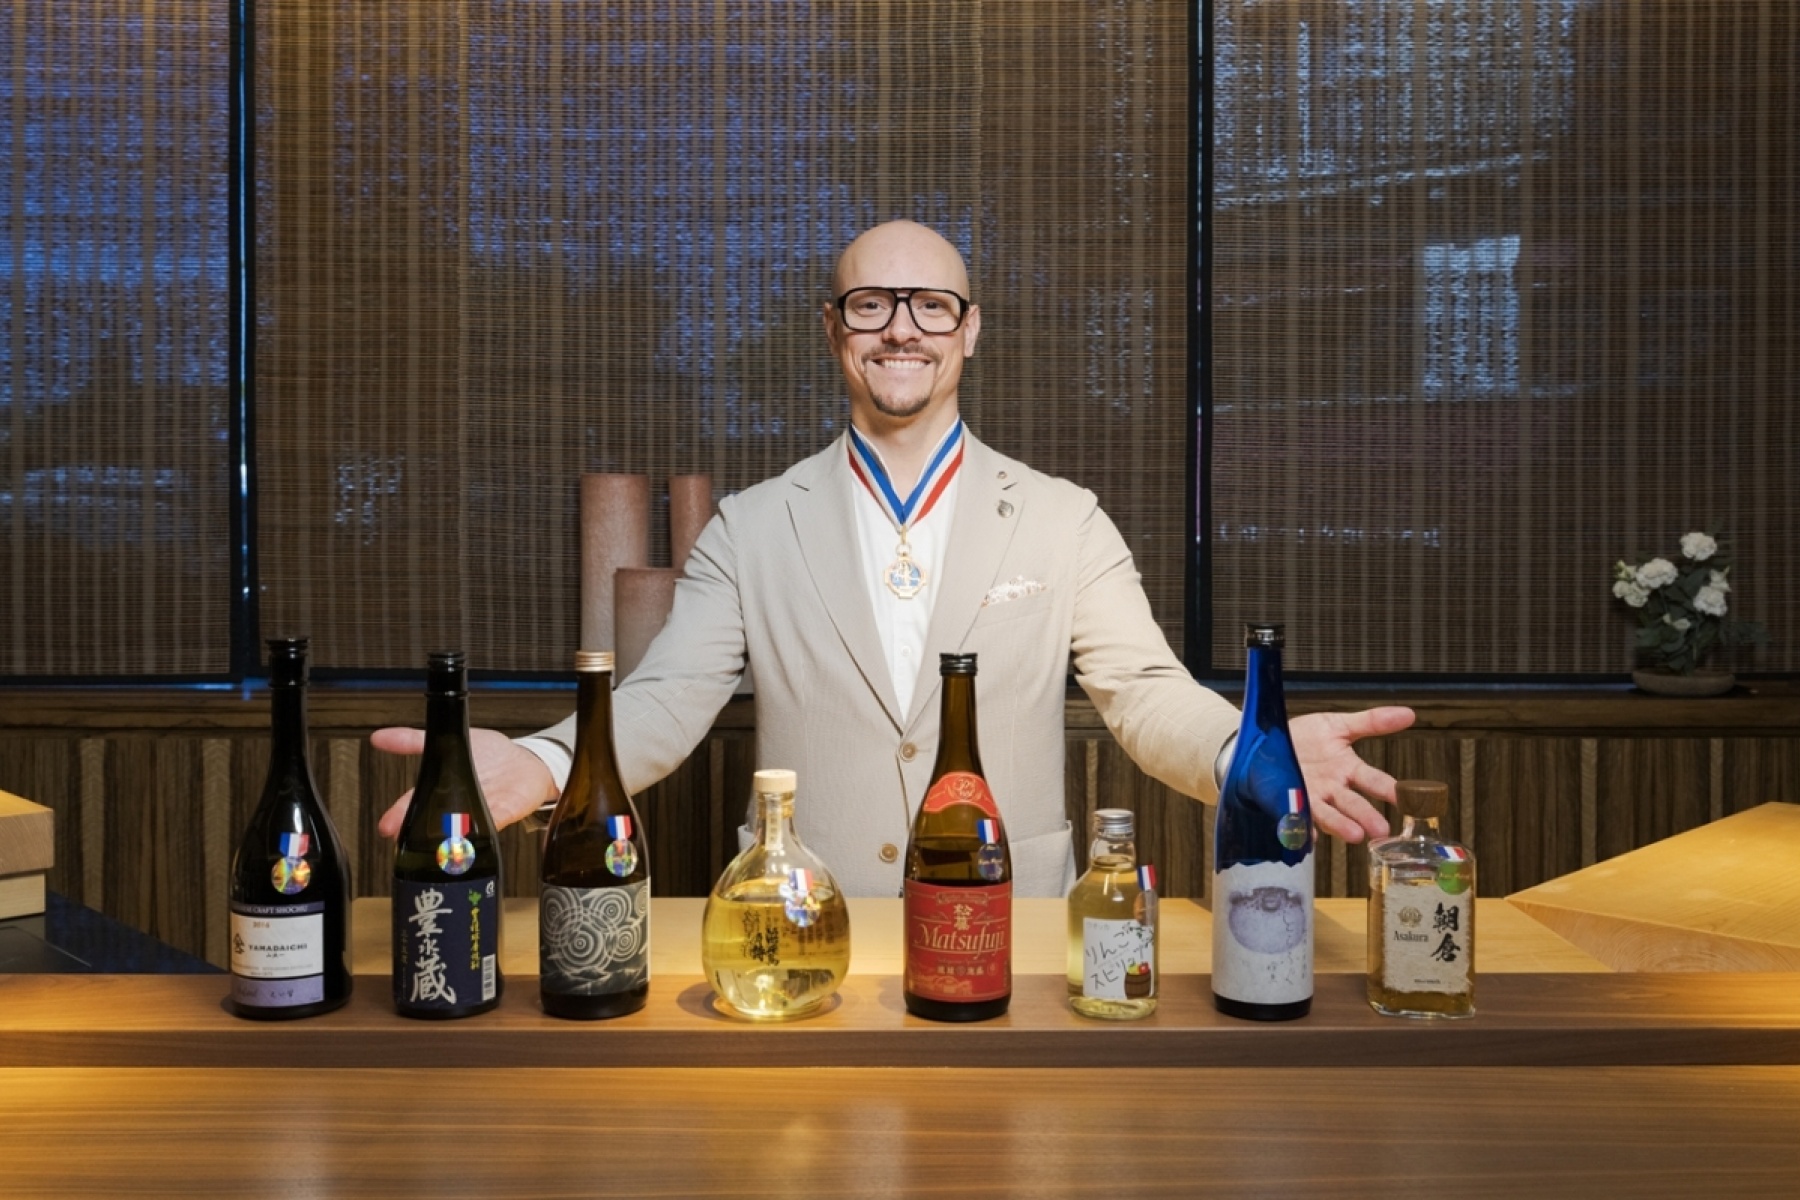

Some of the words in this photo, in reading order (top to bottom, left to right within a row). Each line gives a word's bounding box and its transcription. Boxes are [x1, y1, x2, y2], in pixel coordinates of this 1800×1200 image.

[275, 904, 308, 914] SHOCHU
[1393, 931, 1429, 942] Asakura
[1430, 901, 1461, 962] 朝倉
[914, 922, 1006, 960] Matsufuji
[248, 943, 308, 952] YAMADAICHI
